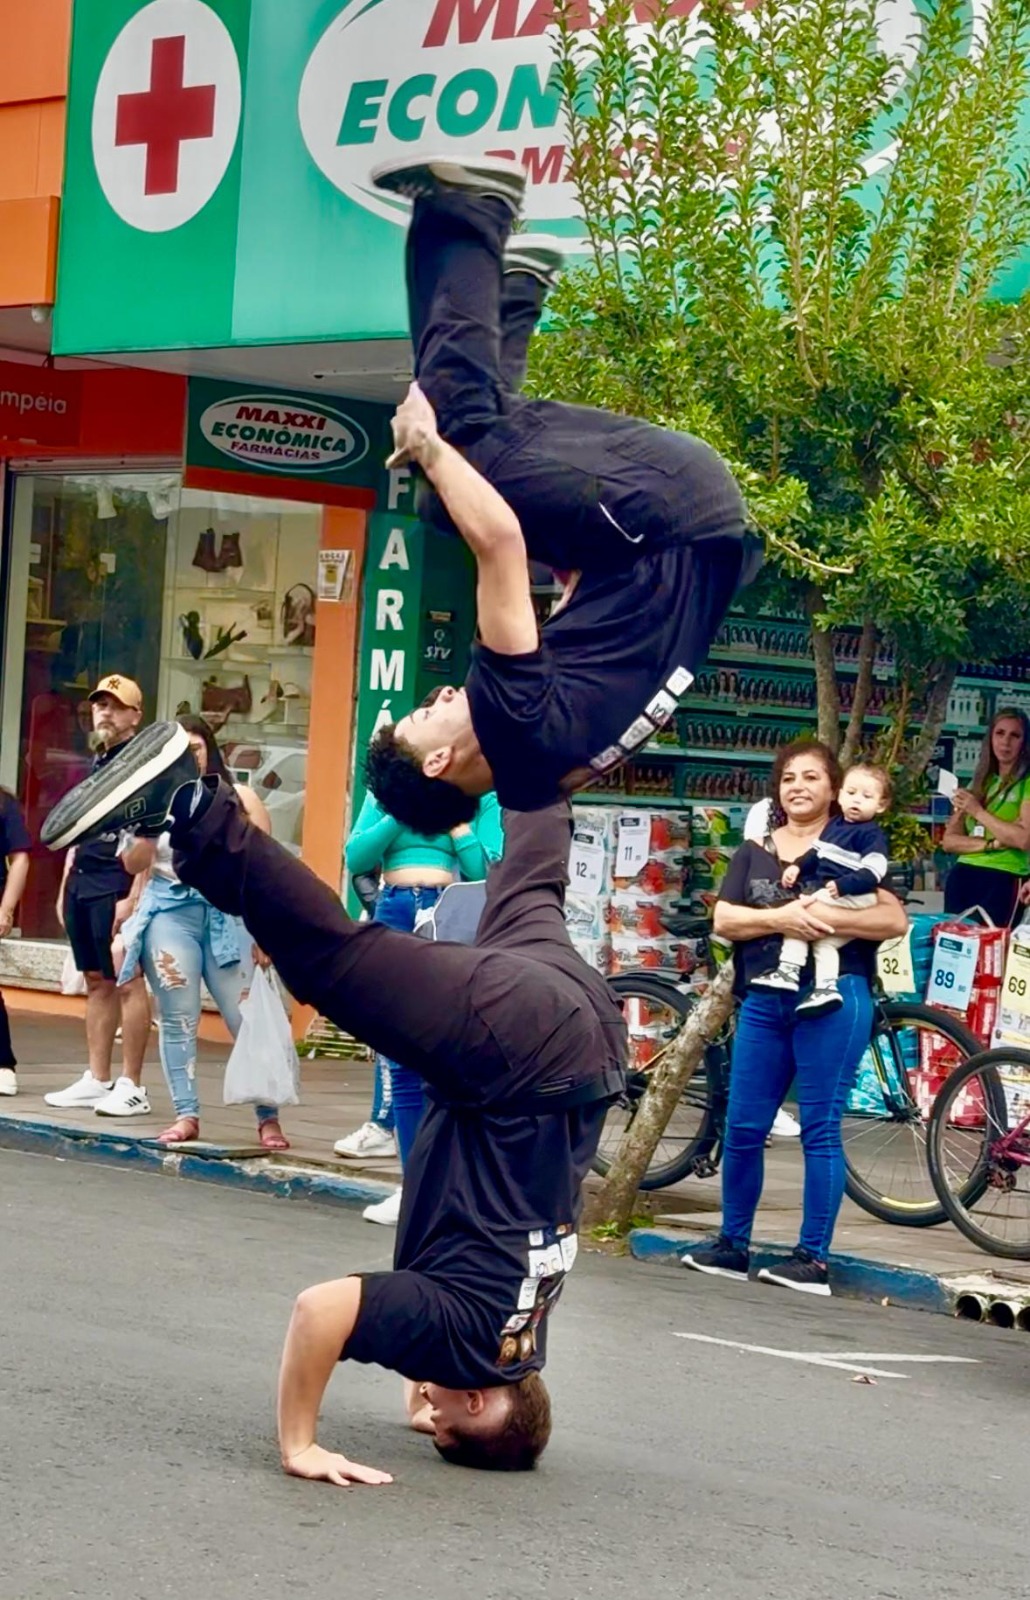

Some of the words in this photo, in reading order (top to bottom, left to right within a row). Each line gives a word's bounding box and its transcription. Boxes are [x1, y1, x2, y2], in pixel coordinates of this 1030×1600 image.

[236, 406, 327, 431] MAXXI
[211, 422, 347, 453] ECONÔMICA
[624, 845, 634, 861] 11
[575, 861, 588, 878] 12
[882, 957, 900, 976] 32
[934, 968, 955, 989] 89
[1008, 976, 1027, 997] 69
